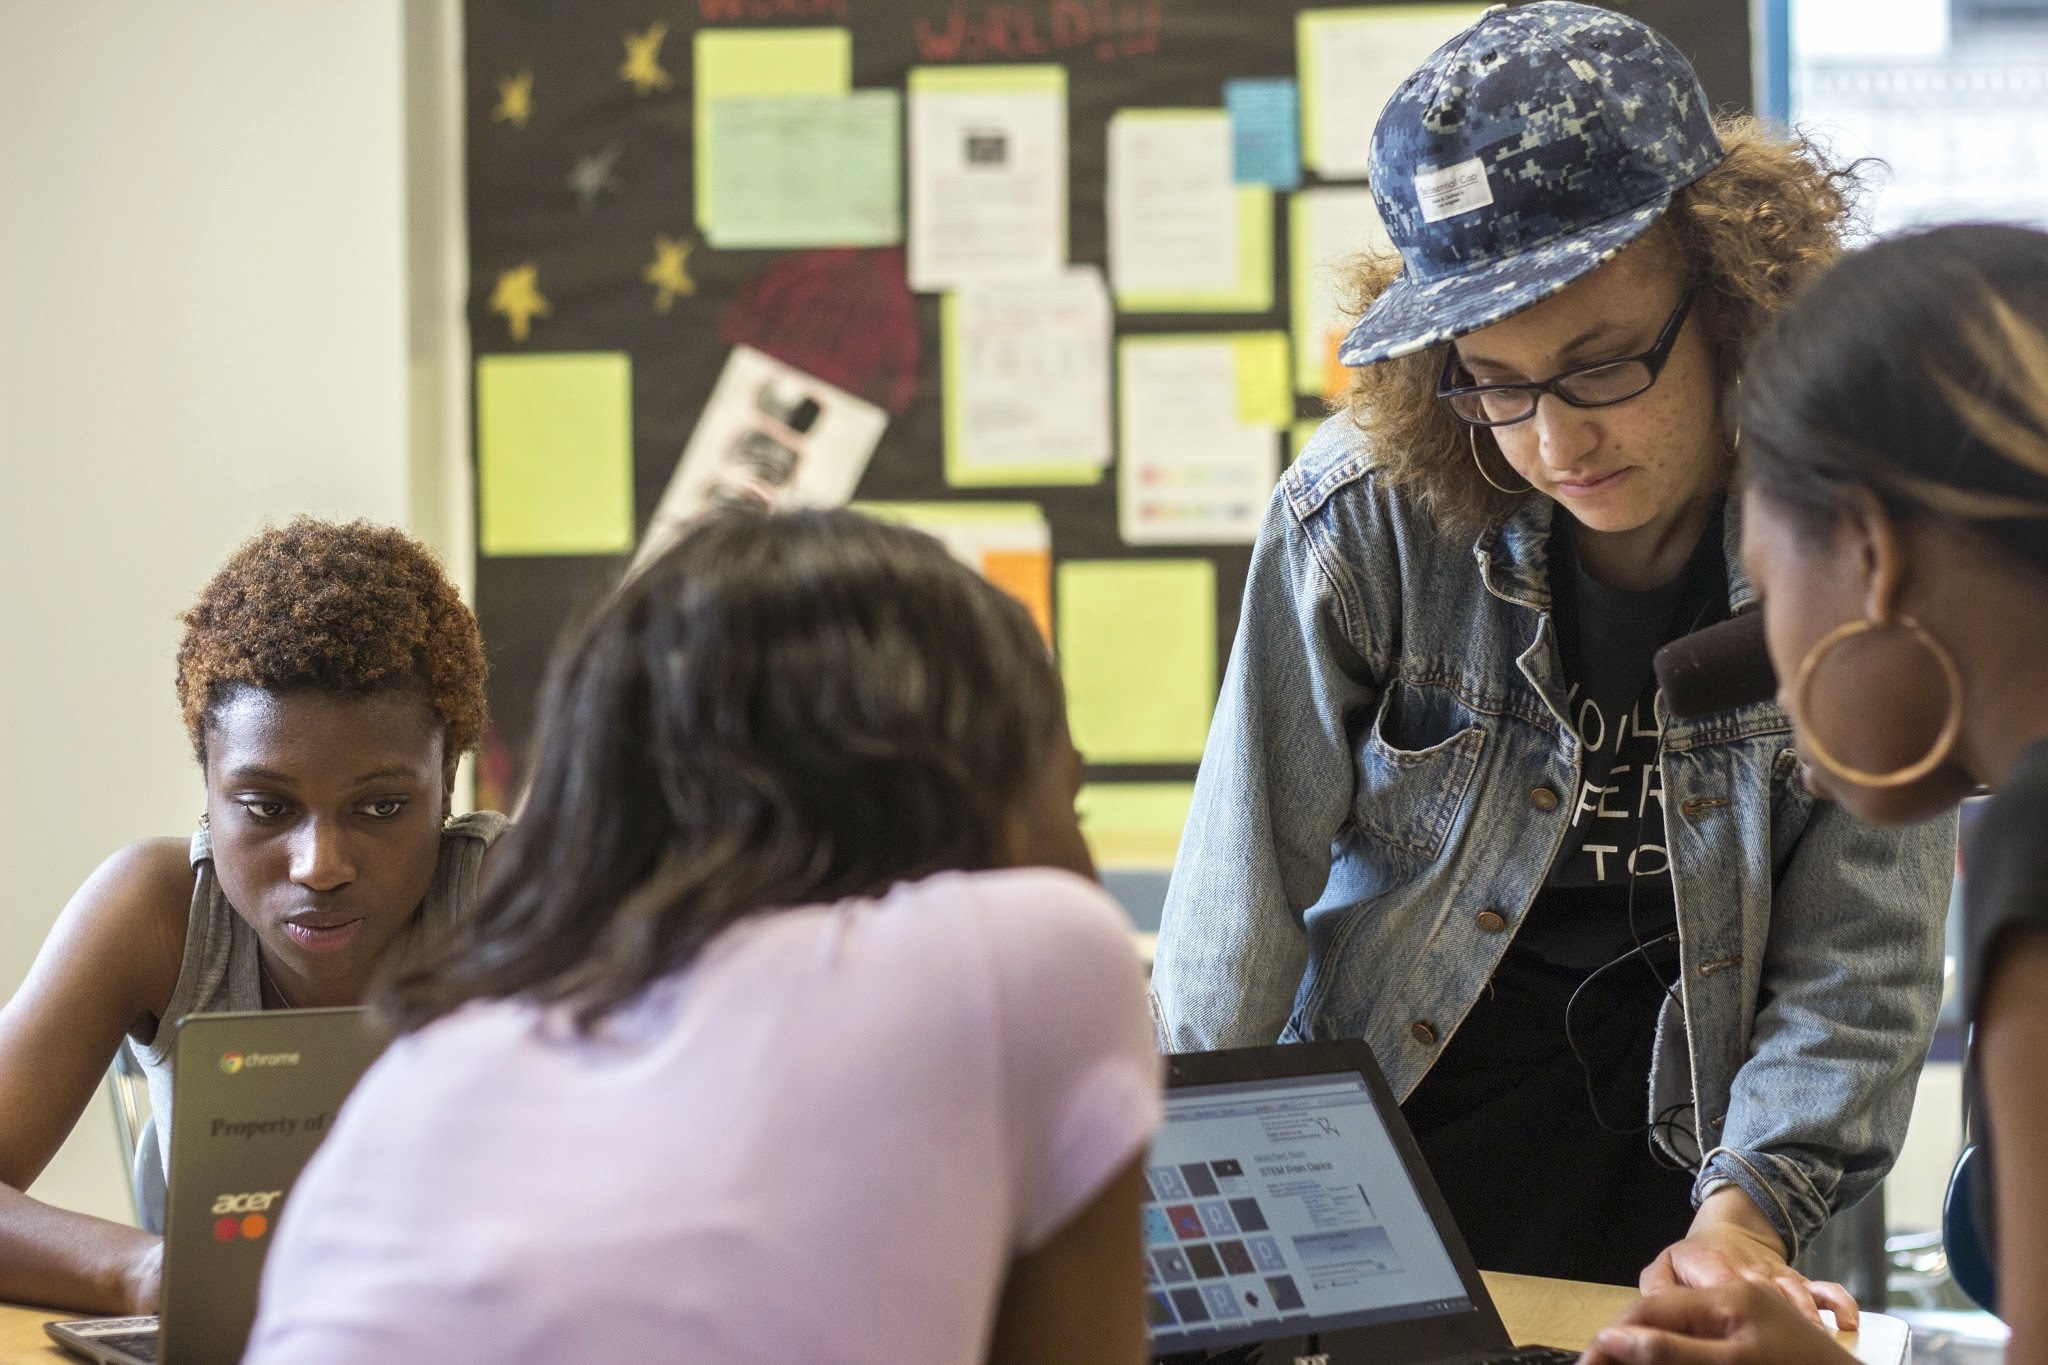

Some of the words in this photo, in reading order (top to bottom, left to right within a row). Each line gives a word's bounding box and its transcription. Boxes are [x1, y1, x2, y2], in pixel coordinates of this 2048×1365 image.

[1582, 844, 1670, 880] TO
[244, 1051, 299, 1068] chrome
[211, 1116, 297, 1140] Property
[303, 1112, 326, 1132] of
[211, 1190, 283, 1214] acer
